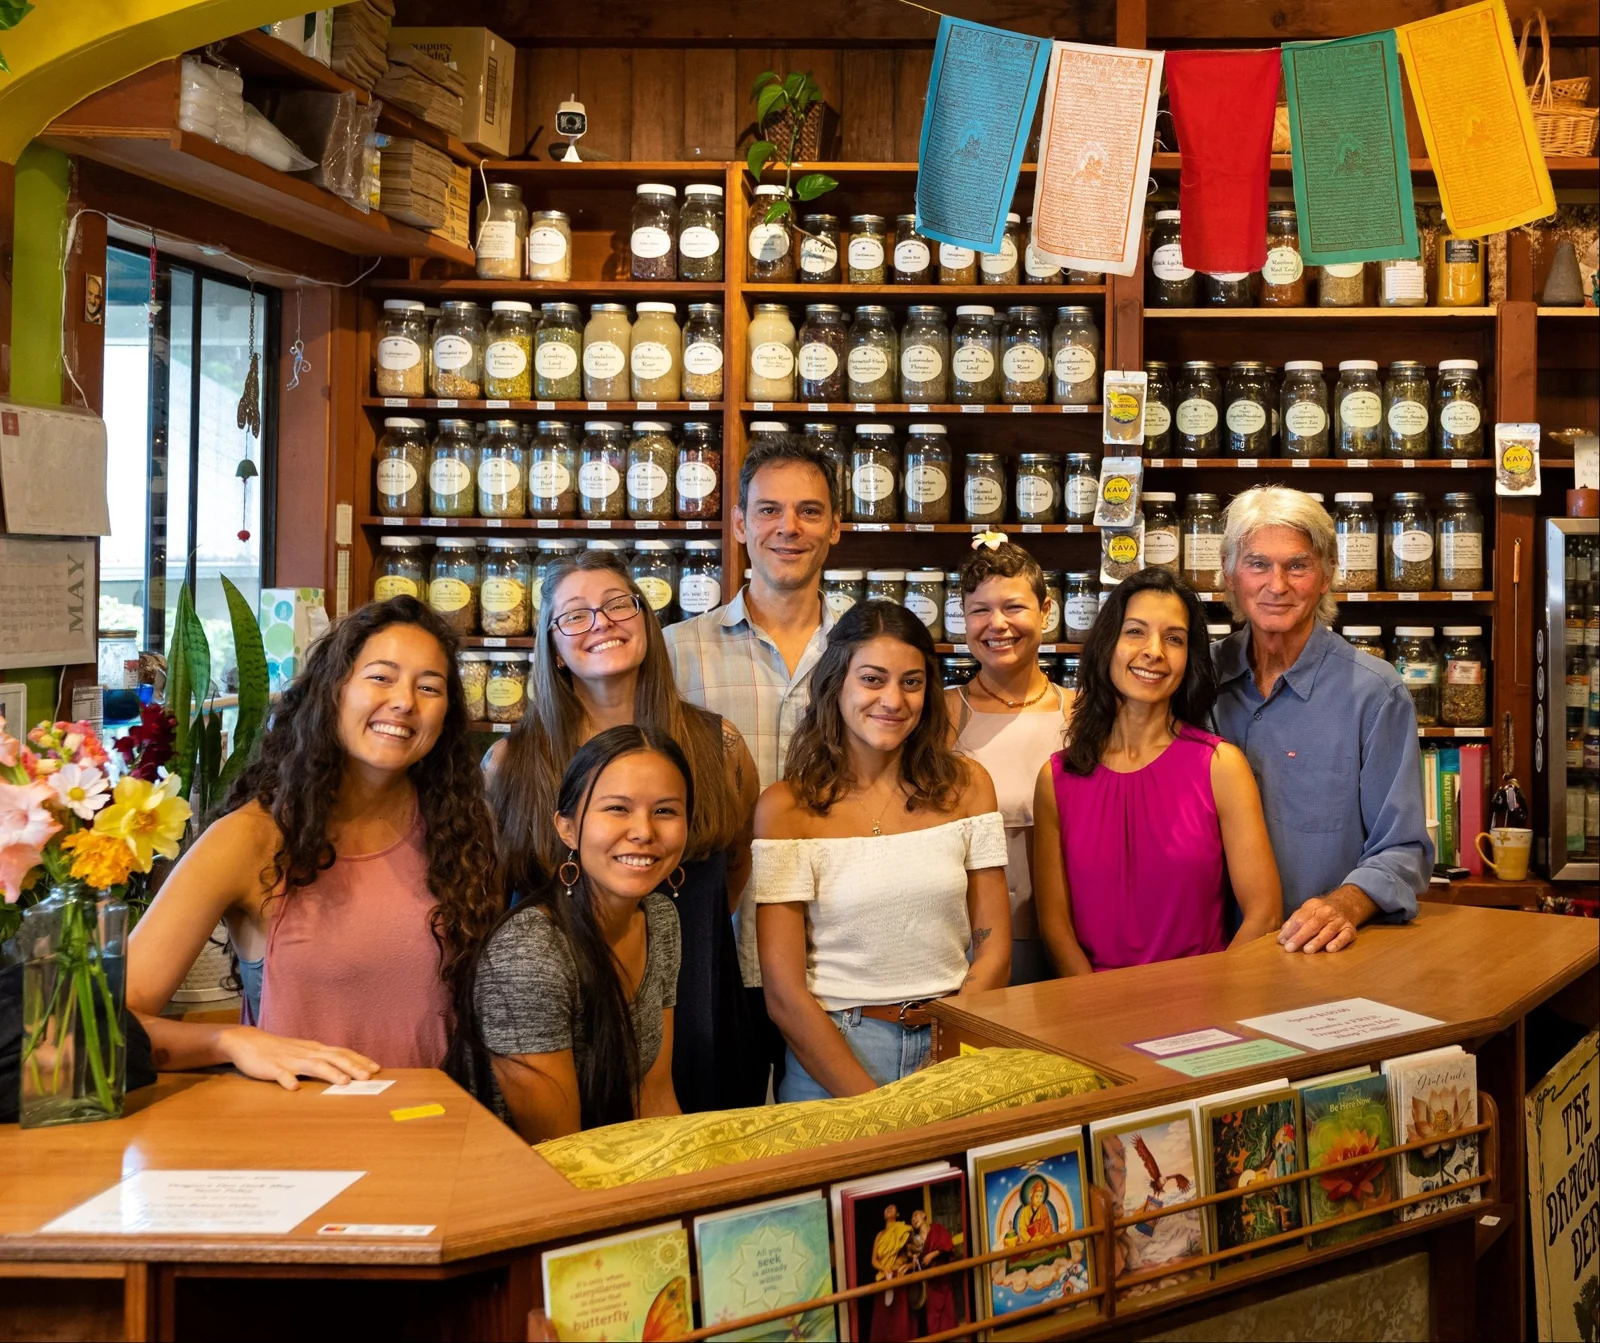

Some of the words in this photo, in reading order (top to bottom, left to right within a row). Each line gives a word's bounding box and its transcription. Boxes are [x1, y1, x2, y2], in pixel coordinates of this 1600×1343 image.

[1506, 455, 1531, 463] KAVA
[67, 554, 85, 635] MAY
[1444, 775, 1452, 813] NATURAL
[1444, 814, 1453, 842] CURES
[1417, 1070, 1467, 1094] Gratitude
[1329, 1104, 1339, 1113] Be
[1340, 1101, 1356, 1111] Here
[1356, 1097, 1371, 1107] Now
[1561, 1082, 1592, 1156] THE
[756, 1248, 766, 1257] All
[768, 1246, 782, 1257] you
[757, 1254, 781, 1269] seek
[605, 1273, 625, 1281] when
[752, 1269, 760, 1277] is
[761, 1264, 788, 1277] already
[759, 1275, 782, 1285] within
[763, 1285, 777, 1294] you
[589, 1297, 605, 1306] done
[606, 1292, 622, 1301] that
[589, 1303, 622, 1315] becomes
[573, 1310, 631, 1333] butterfly
